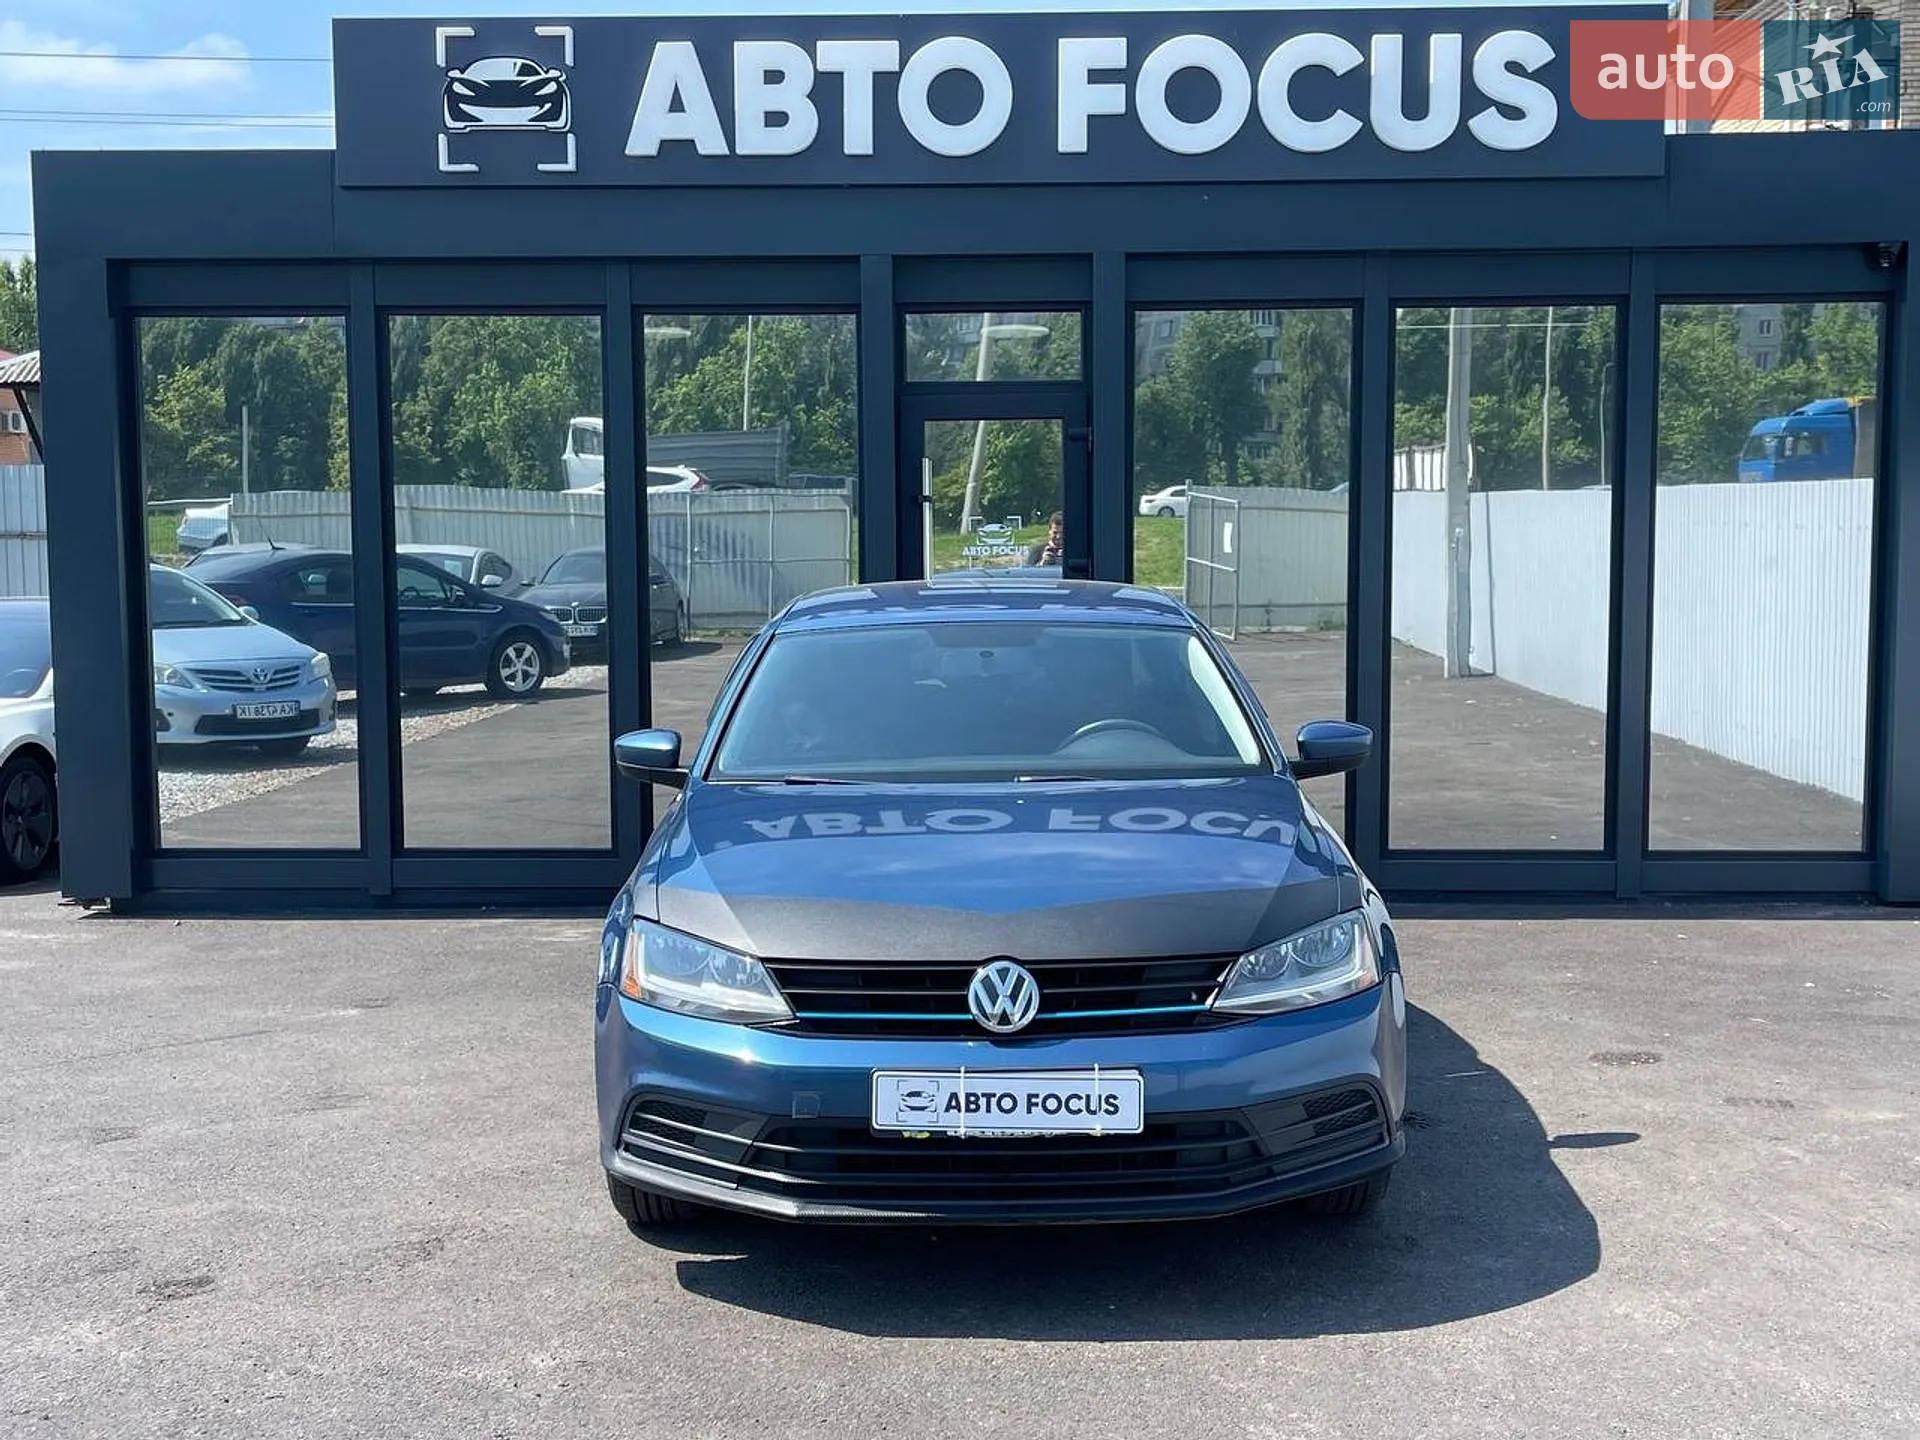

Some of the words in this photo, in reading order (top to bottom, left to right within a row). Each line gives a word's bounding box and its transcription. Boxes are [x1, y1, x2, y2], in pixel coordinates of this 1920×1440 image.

[625, 36, 1012, 157] АВТО
[1056, 31, 1559, 154] FOCUS
[992, 545, 1030, 556] FOCUS
[1025, 1092, 1121, 1116] FOCUS
